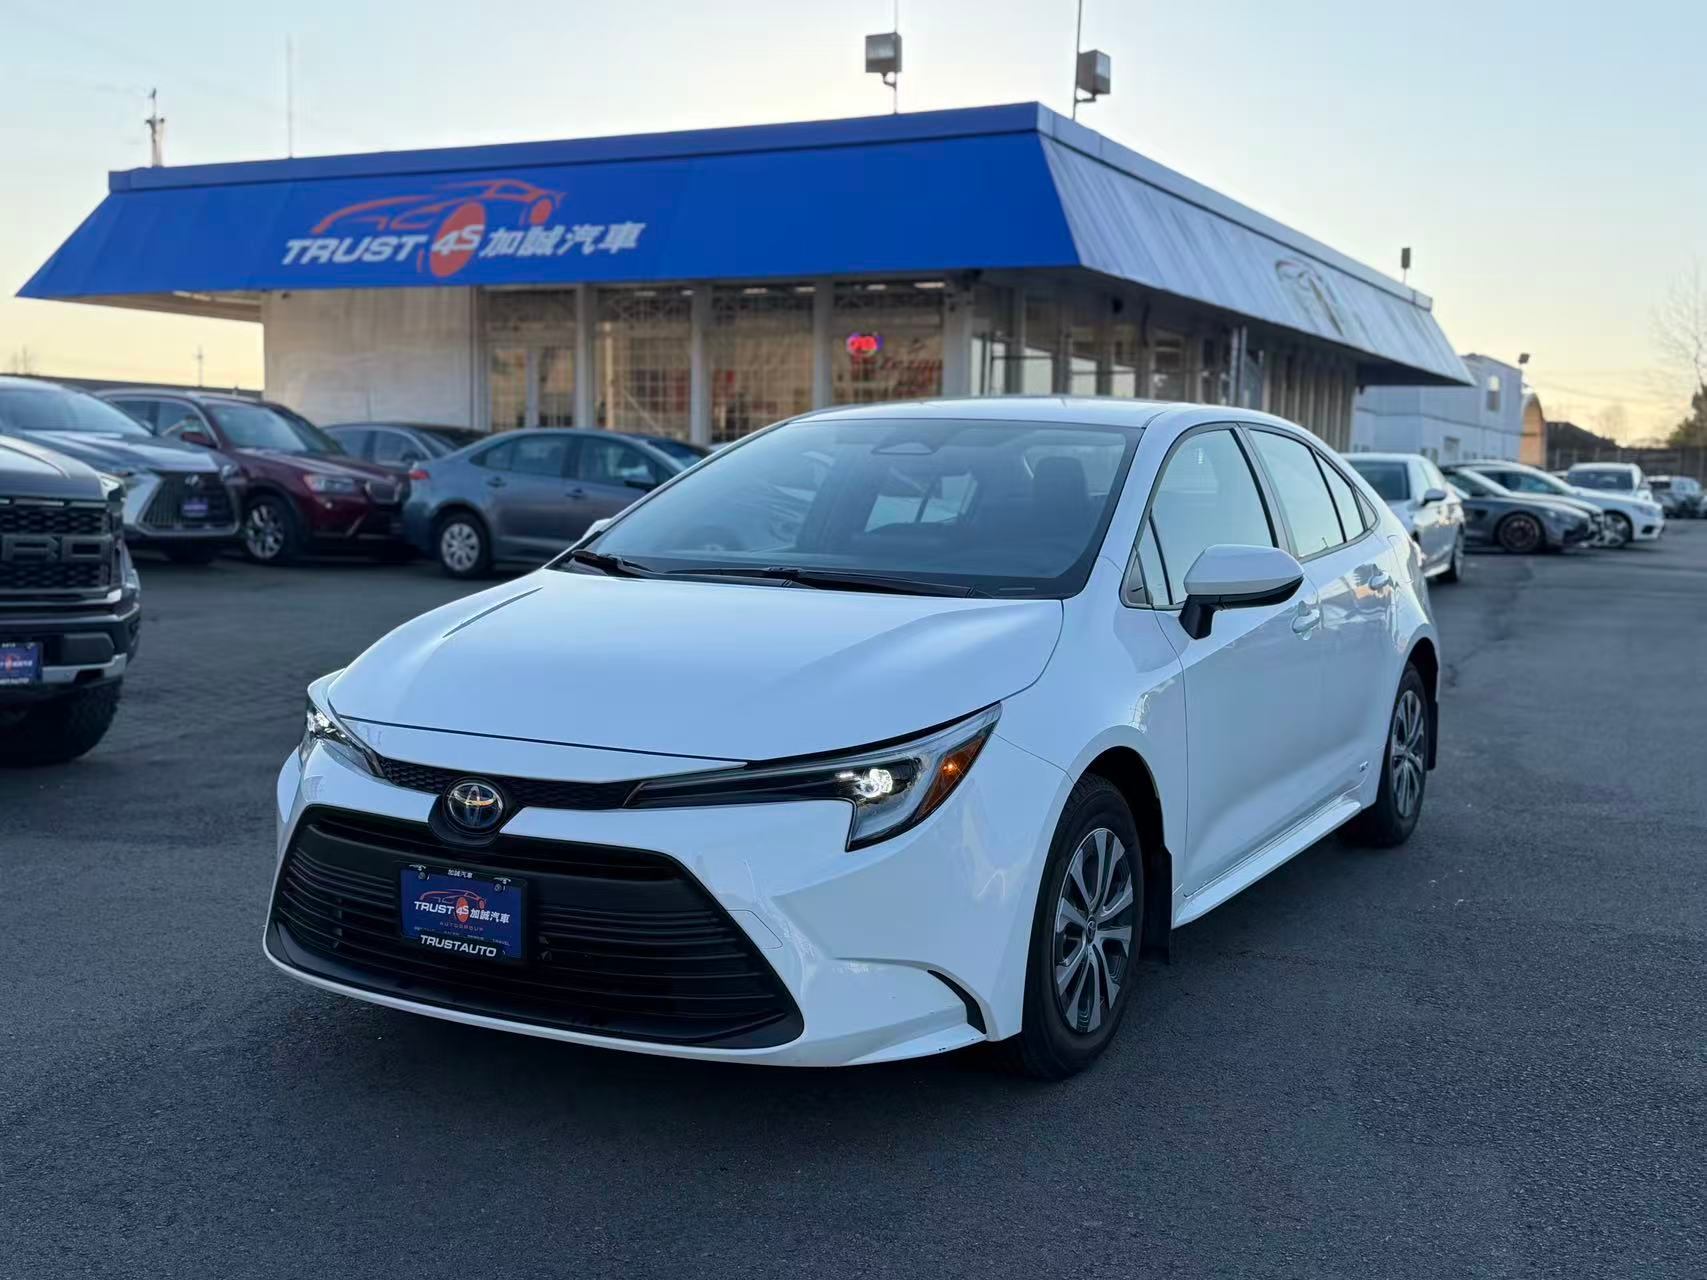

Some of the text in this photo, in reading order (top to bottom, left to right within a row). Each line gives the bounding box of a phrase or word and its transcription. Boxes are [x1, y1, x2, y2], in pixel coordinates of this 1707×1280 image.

[282, 235, 427, 264] TRUST
[432, 224, 484, 256] 4S
[414, 901, 510, 923] TRUST 4S 加誠汽車
[420, 934, 497, 957] TRUSTAUTO
